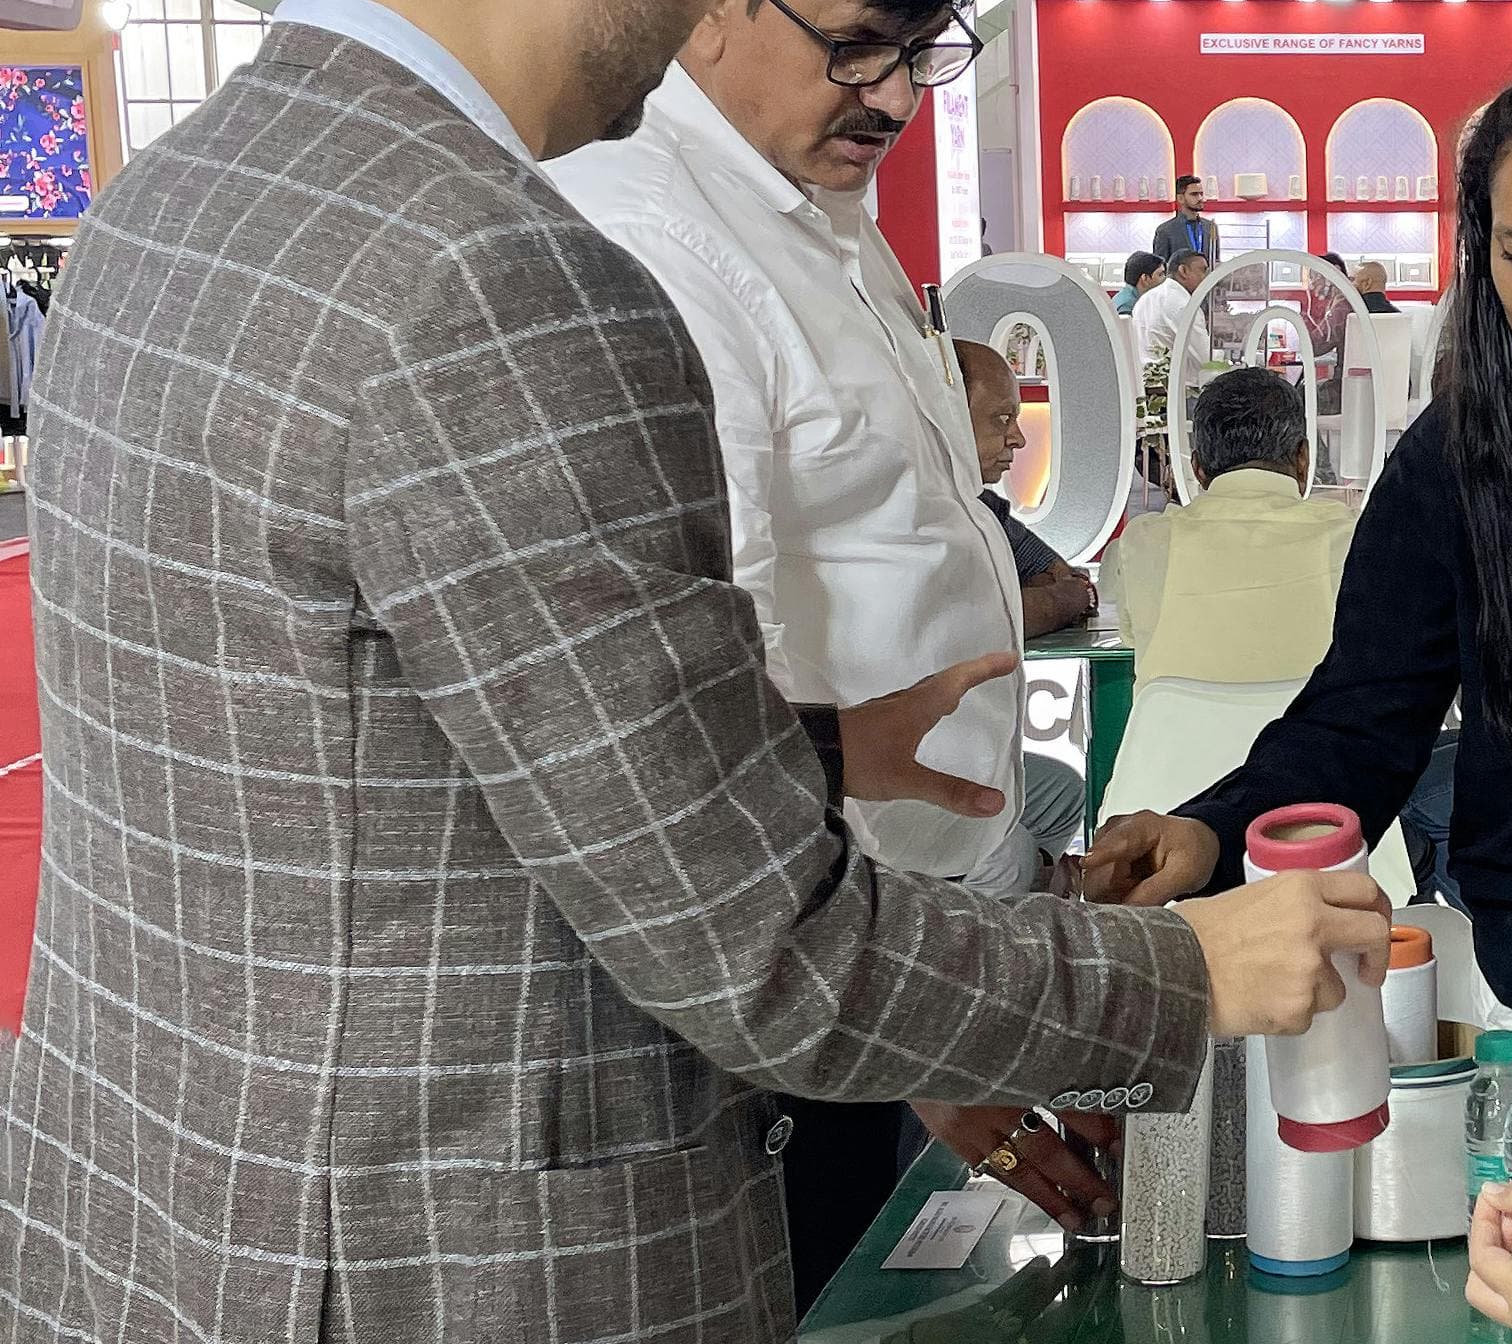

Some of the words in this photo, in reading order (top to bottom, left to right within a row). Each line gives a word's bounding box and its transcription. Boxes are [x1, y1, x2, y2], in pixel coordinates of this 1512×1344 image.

[1202, 38, 1270, 49] EXCLUSIVE
[1273, 38, 1316, 49] RANGE
[1318, 38, 1335, 49] OF
[1338, 38, 1379, 49] FANCY
[1381, 38, 1422, 49] YARNS
